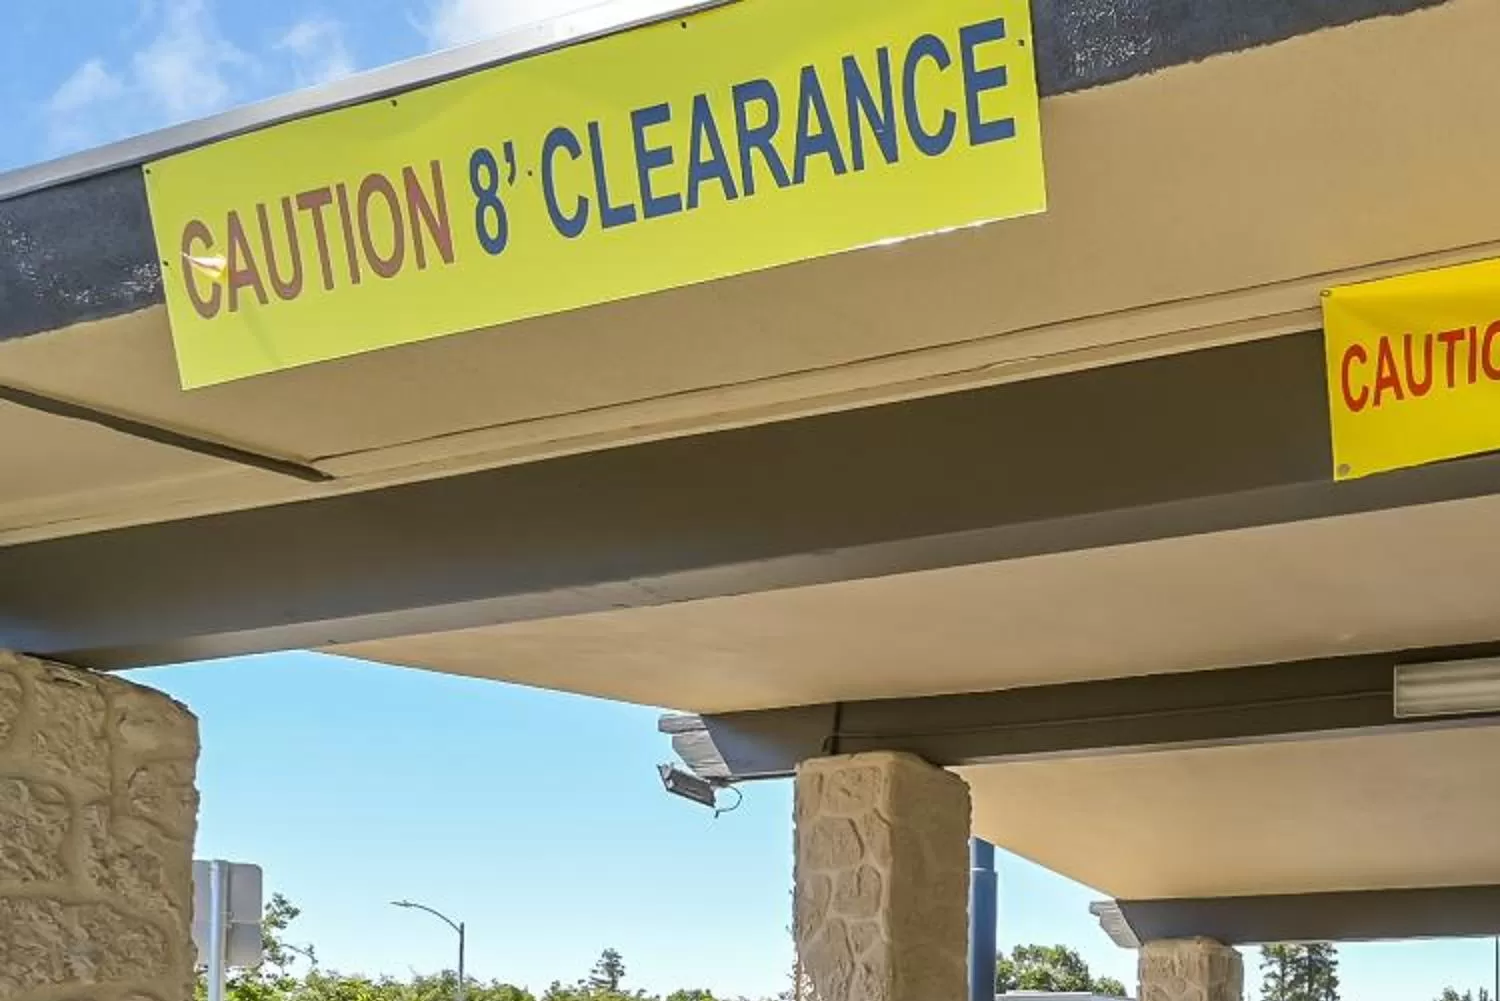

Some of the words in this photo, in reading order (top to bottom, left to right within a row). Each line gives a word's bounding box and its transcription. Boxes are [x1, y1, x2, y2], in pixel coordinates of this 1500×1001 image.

[180, 159, 455, 320] CAUTION
[469, 141, 518, 256] 8'
[541, 18, 1016, 239] CLEARANCE
